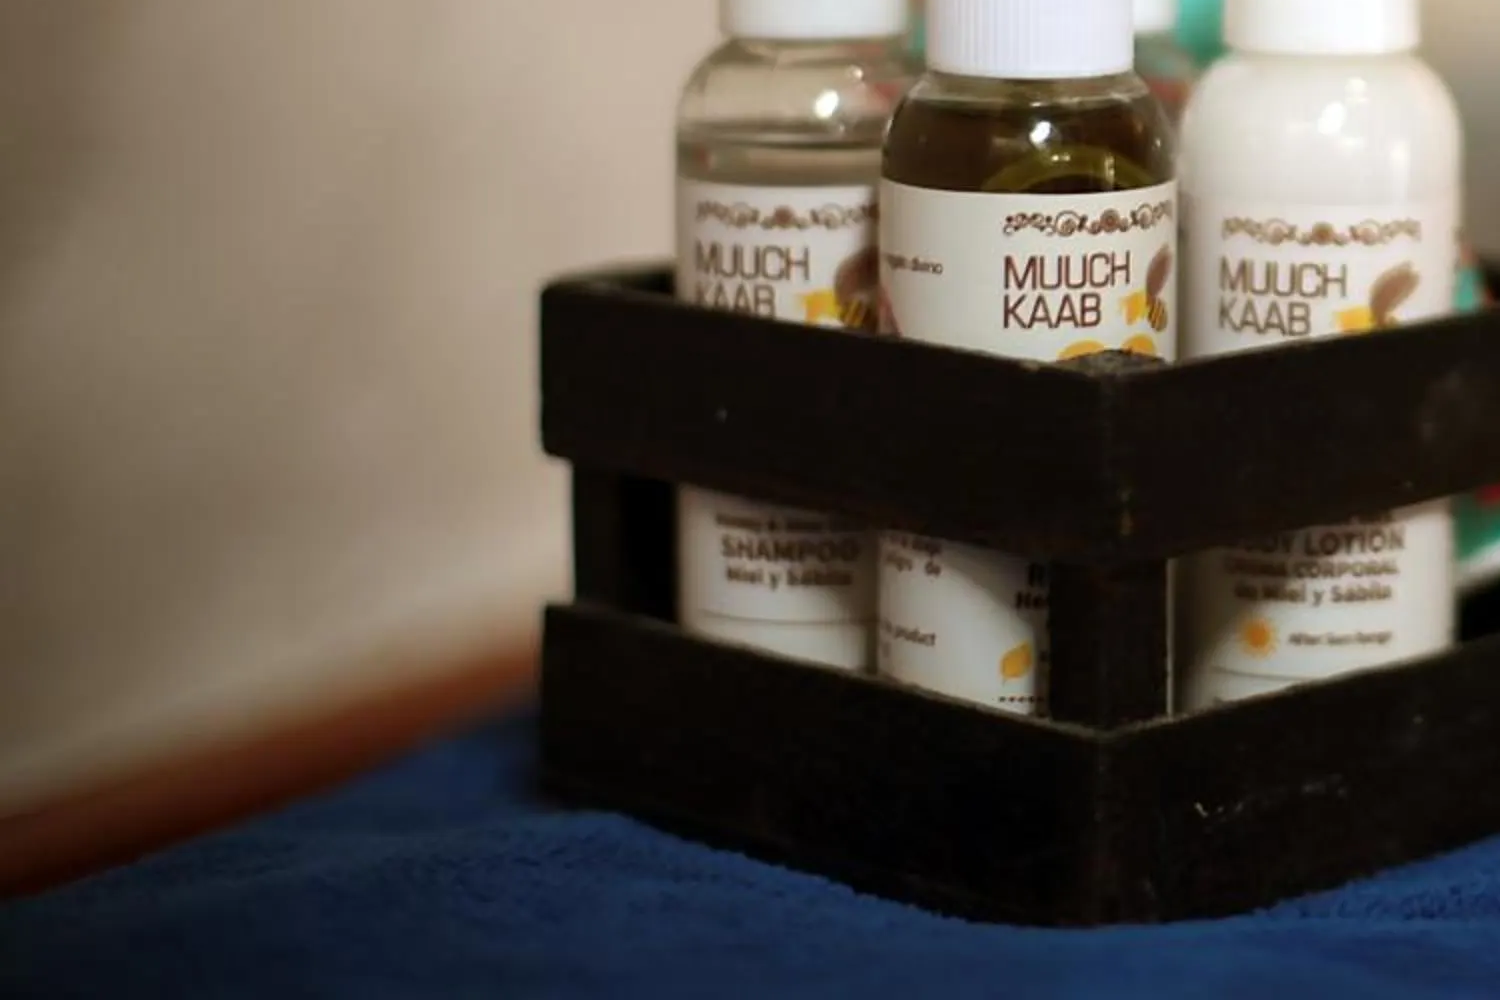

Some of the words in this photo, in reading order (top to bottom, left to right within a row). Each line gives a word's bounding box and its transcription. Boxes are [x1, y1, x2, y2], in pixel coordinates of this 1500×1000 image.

[696, 241, 809, 281] MUUCH
[1003, 251, 1130, 290] MUUCH
[1219, 256, 1347, 298] MUUCH
[695, 283, 776, 318] KAAB
[1003, 294, 1101, 329] KAAB
[1219, 297, 1312, 336] KAAB
[722, 533, 857, 562] SHAMPOO
[1305, 524, 1404, 556] LOTION
[727, 567, 764, 583] Miel
[1295, 558, 1398, 579] CORPORAL
[1263, 583, 1306, 603] Miel
[1312, 589, 1323, 608] y
